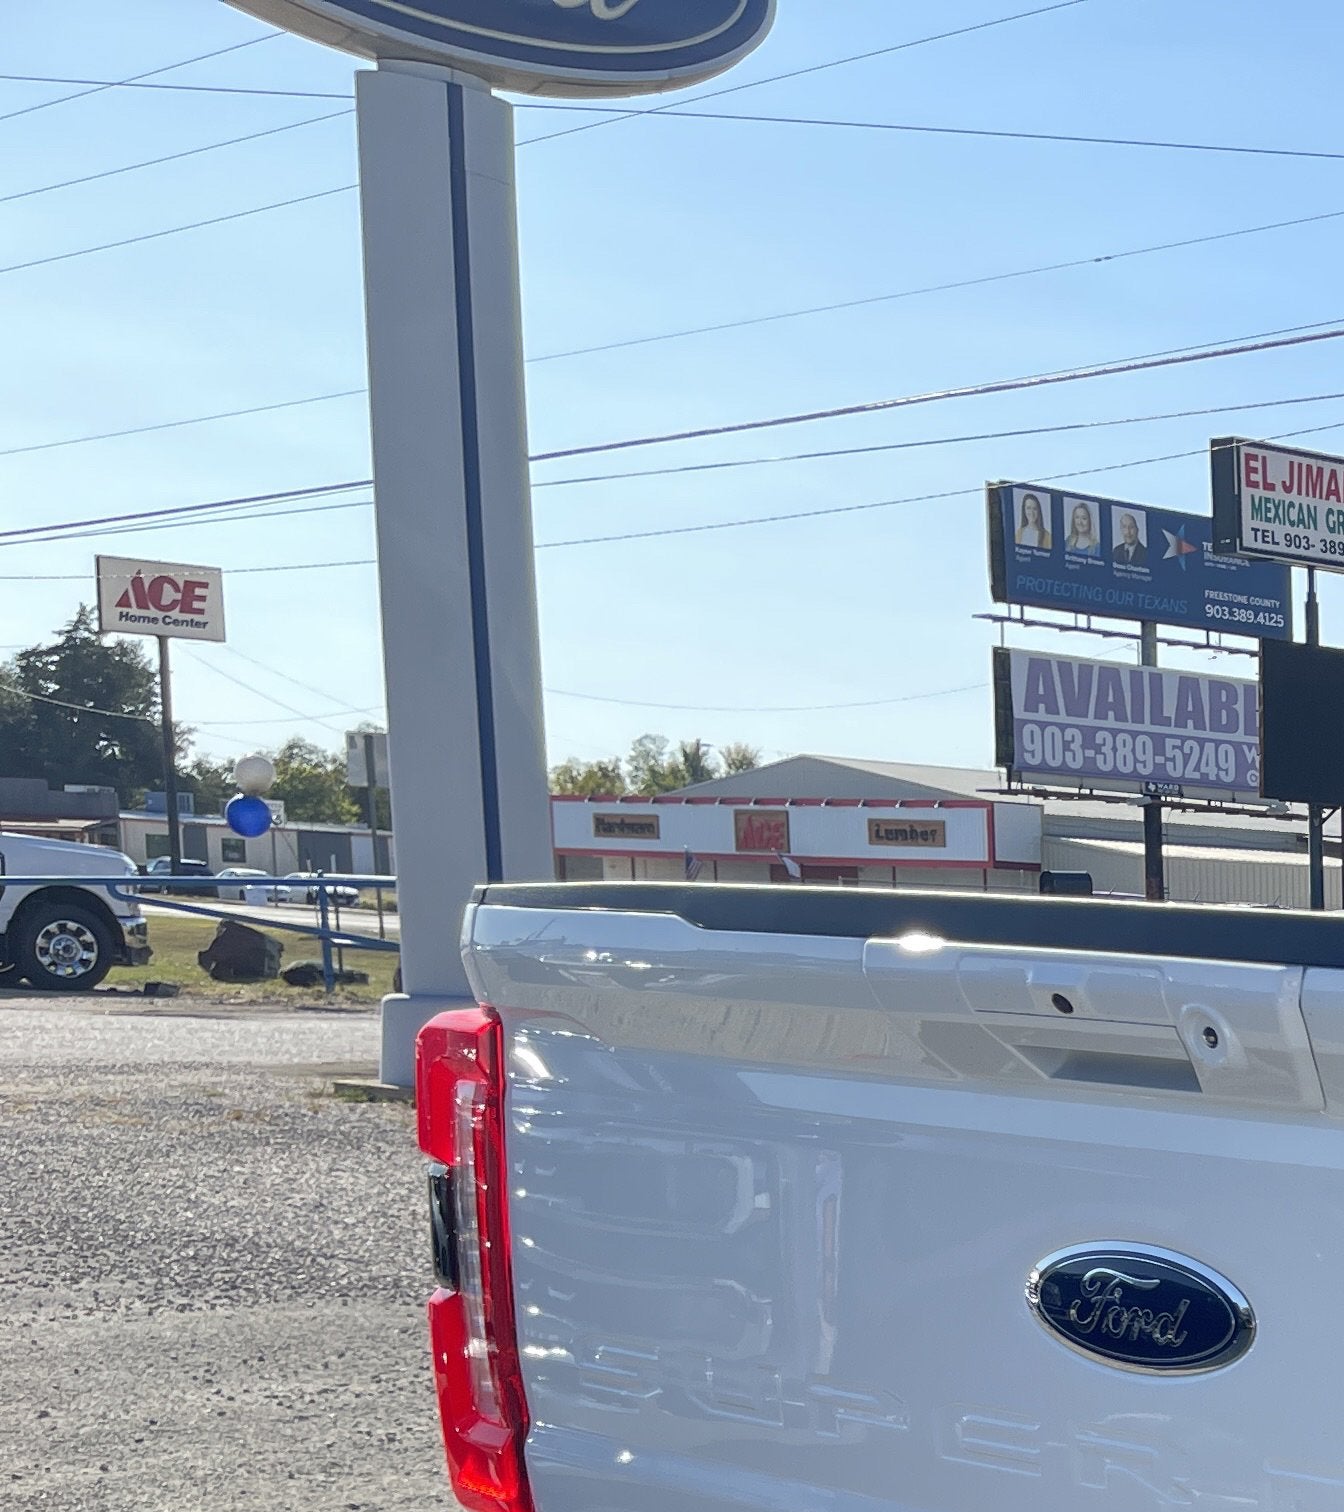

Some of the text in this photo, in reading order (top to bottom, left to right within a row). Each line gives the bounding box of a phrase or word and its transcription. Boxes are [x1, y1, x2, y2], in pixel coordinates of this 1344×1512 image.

[1244, 453, 1276, 492] EL
[1250, 494, 1318, 531] MEXICAN
[1250, 528, 1280, 546] TEL
[114, 569, 209, 616] ACE
[1016, 575, 1188, 615] PROTECTING OUR TEXANS
[1204, 589, 1281, 609] FREESTONE COUNTY
[118, 611, 209, 629] Home Center
[1204, 604, 1285, 628] 903.389.4125
[1023, 657, 1260, 737] AVAILABL
[1022, 723, 1237, 783] 903-389-5249
[874, 824, 937, 843] Lumber
[1069, 1266, 1191, 1348] Ford
